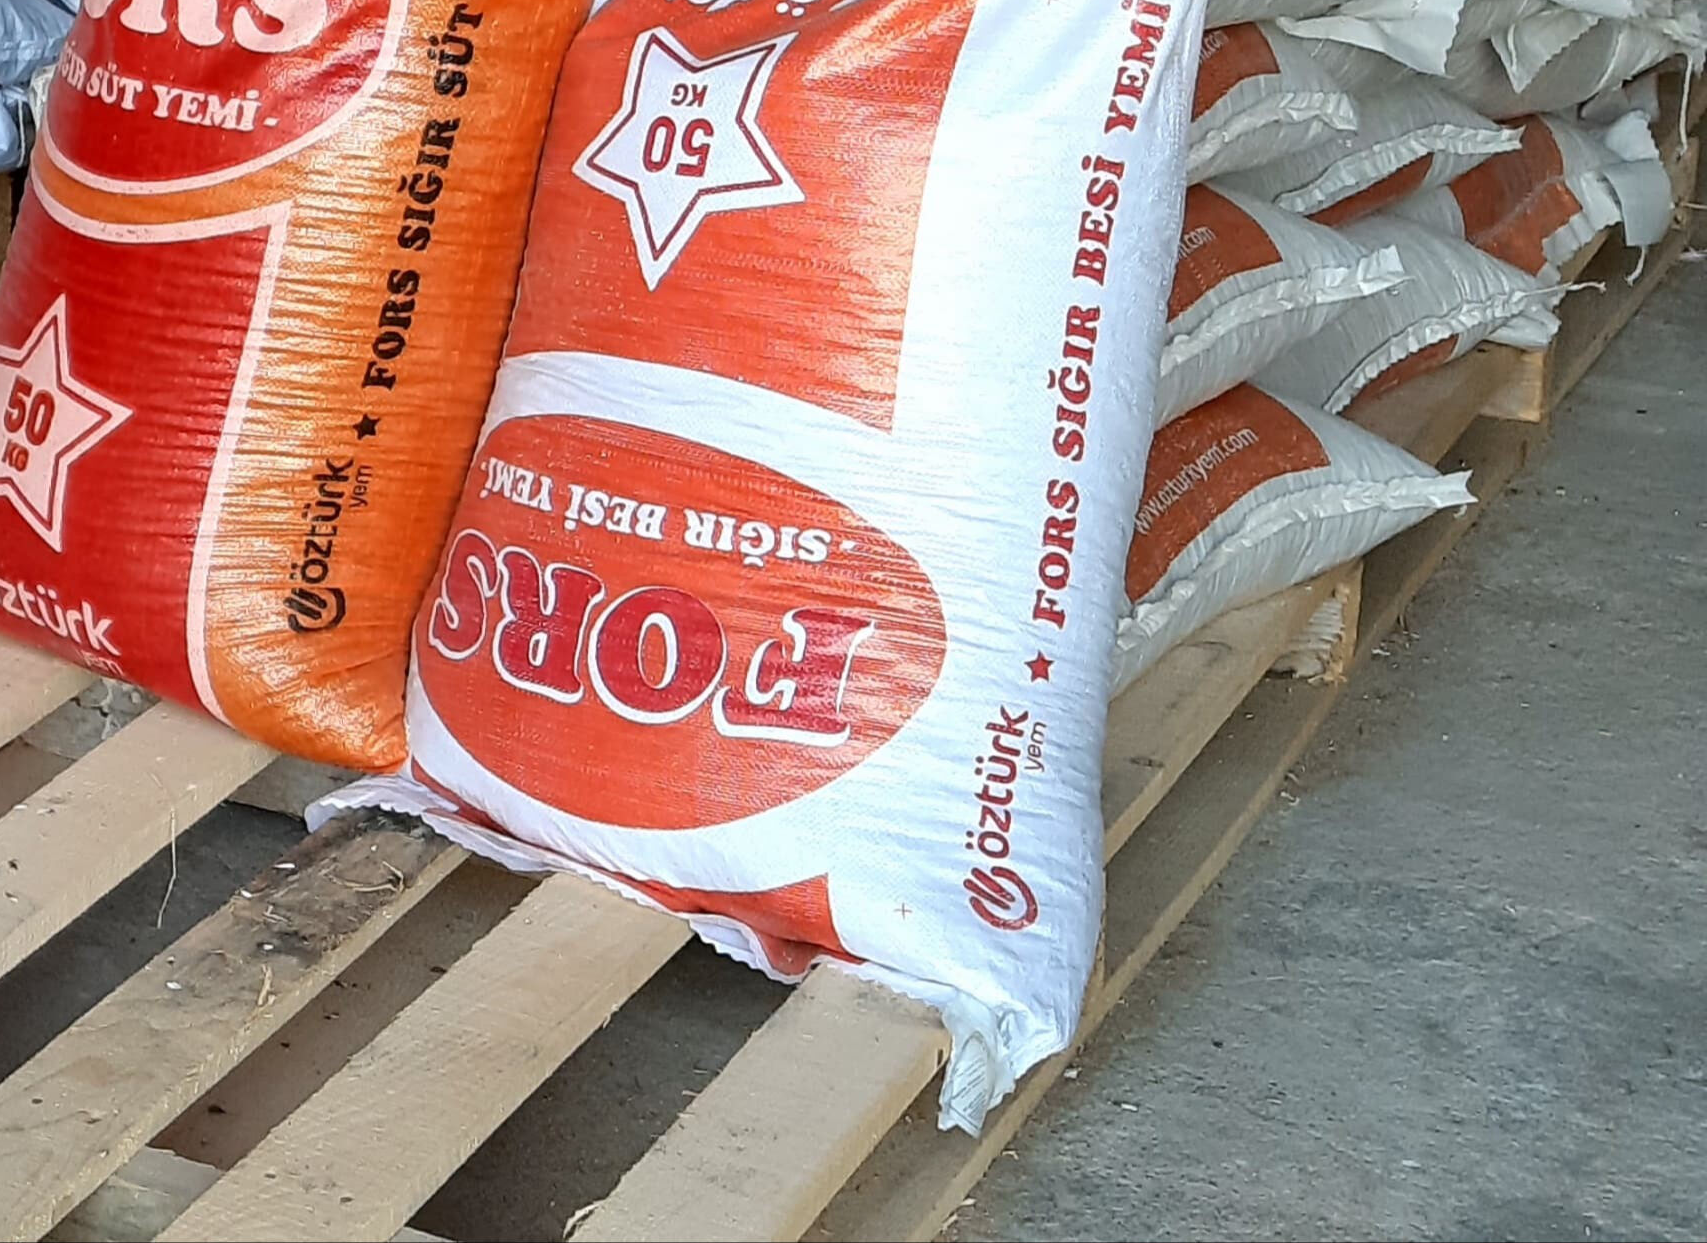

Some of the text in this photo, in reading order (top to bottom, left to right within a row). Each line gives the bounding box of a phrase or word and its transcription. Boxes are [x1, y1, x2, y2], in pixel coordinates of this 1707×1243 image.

[87, 63, 144, 111] SÜT
[151, 89, 261, 133] YEMİ
[428, 2, 483, 99] SÜT
[671, 83, 709, 107] KG
[395, 116, 463, 254] SIĞIR
[641, 114, 714, 178] 50
[1073, 152, 1128, 290] BESİ
[362, 268, 423, 394] FORS
[1045, 303, 1103, 464] SIĞIR
[1, 439, 31, 474] KG
[4, 374, 57, 448] 50
[290, 455, 355, 585] öztürk
[349, 463, 375, 510] yem
[487, 456, 832, 569] SIĞIR BESİ YEMİ
[1031, 478, 1079, 631] FORS
[427, 529, 878, 748] FORS
[979, 704, 1031, 863] öztürk
[1024, 718, 1048, 774] yem
